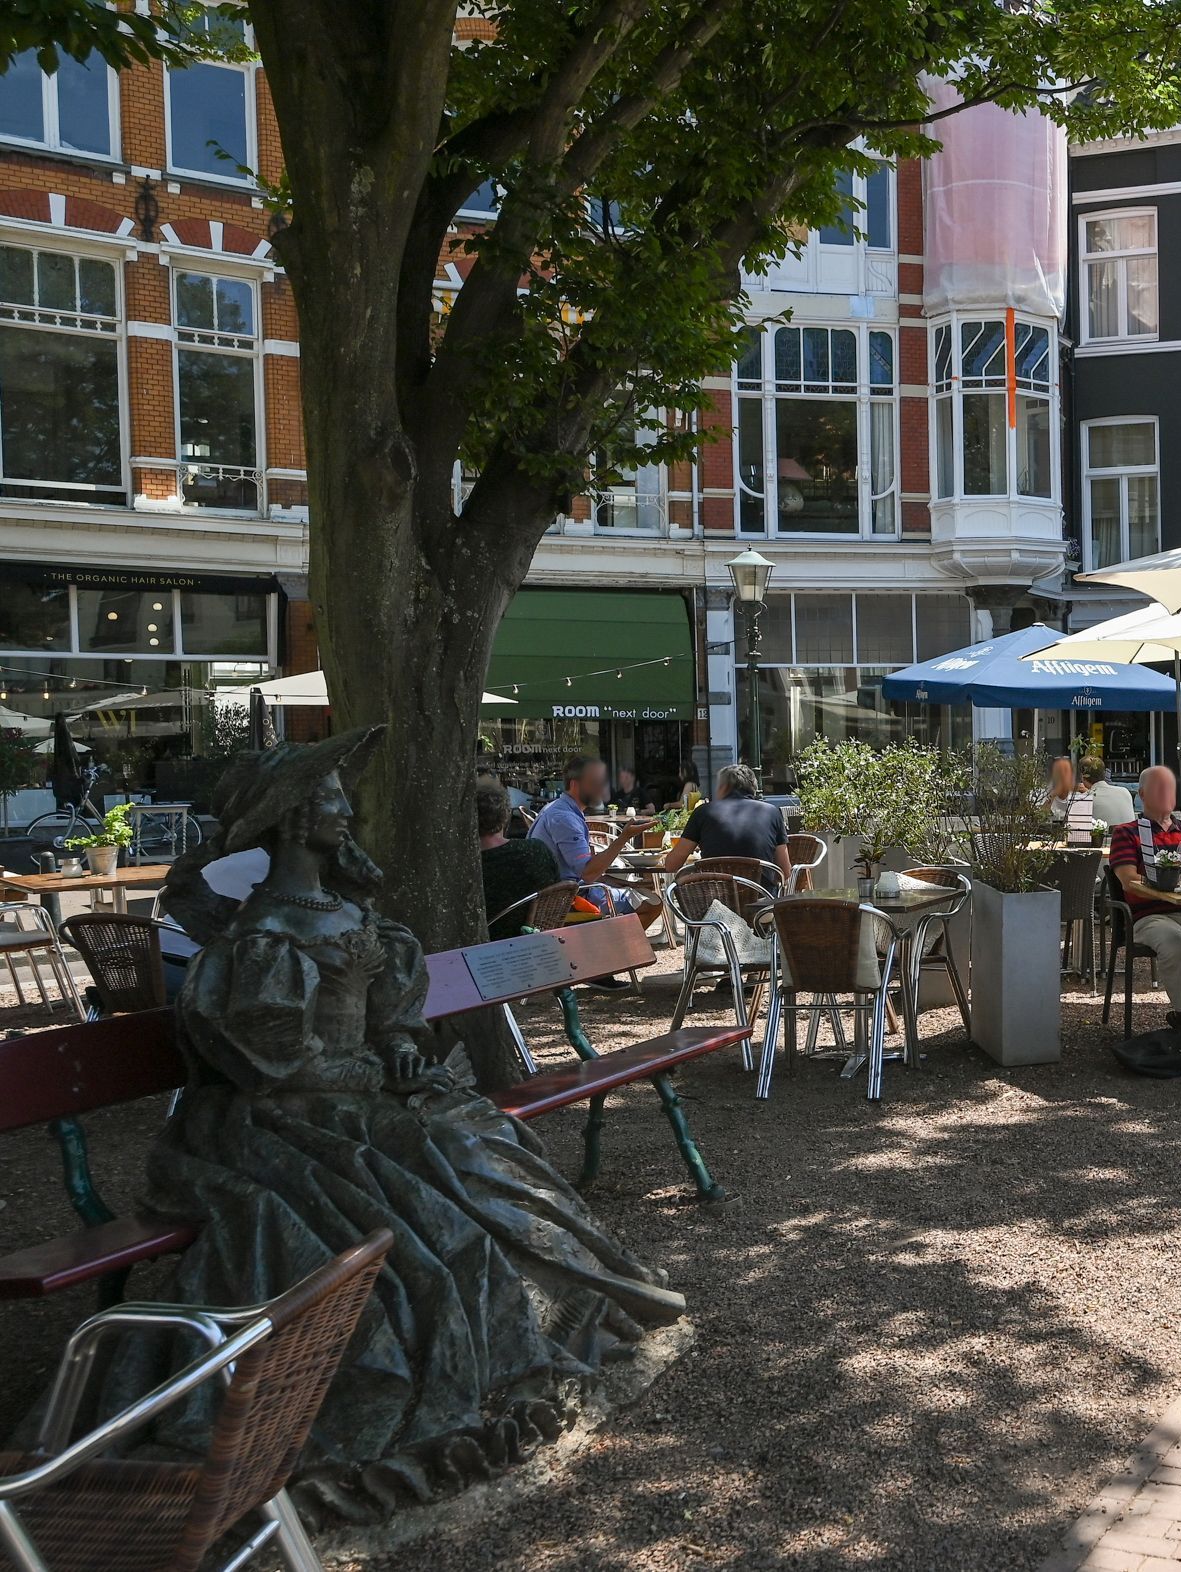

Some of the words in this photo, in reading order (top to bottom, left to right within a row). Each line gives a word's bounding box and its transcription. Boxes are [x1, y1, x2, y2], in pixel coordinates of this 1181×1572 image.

[50, 572, 73, 581] THE
[76, 574, 128, 584] ORGANIC
[131, 576, 156, 585] HAIR
[159, 577, 195, 587] SALON
[552, 705, 600, 717] ROOM
[502, 744, 542, 754] ROOM
